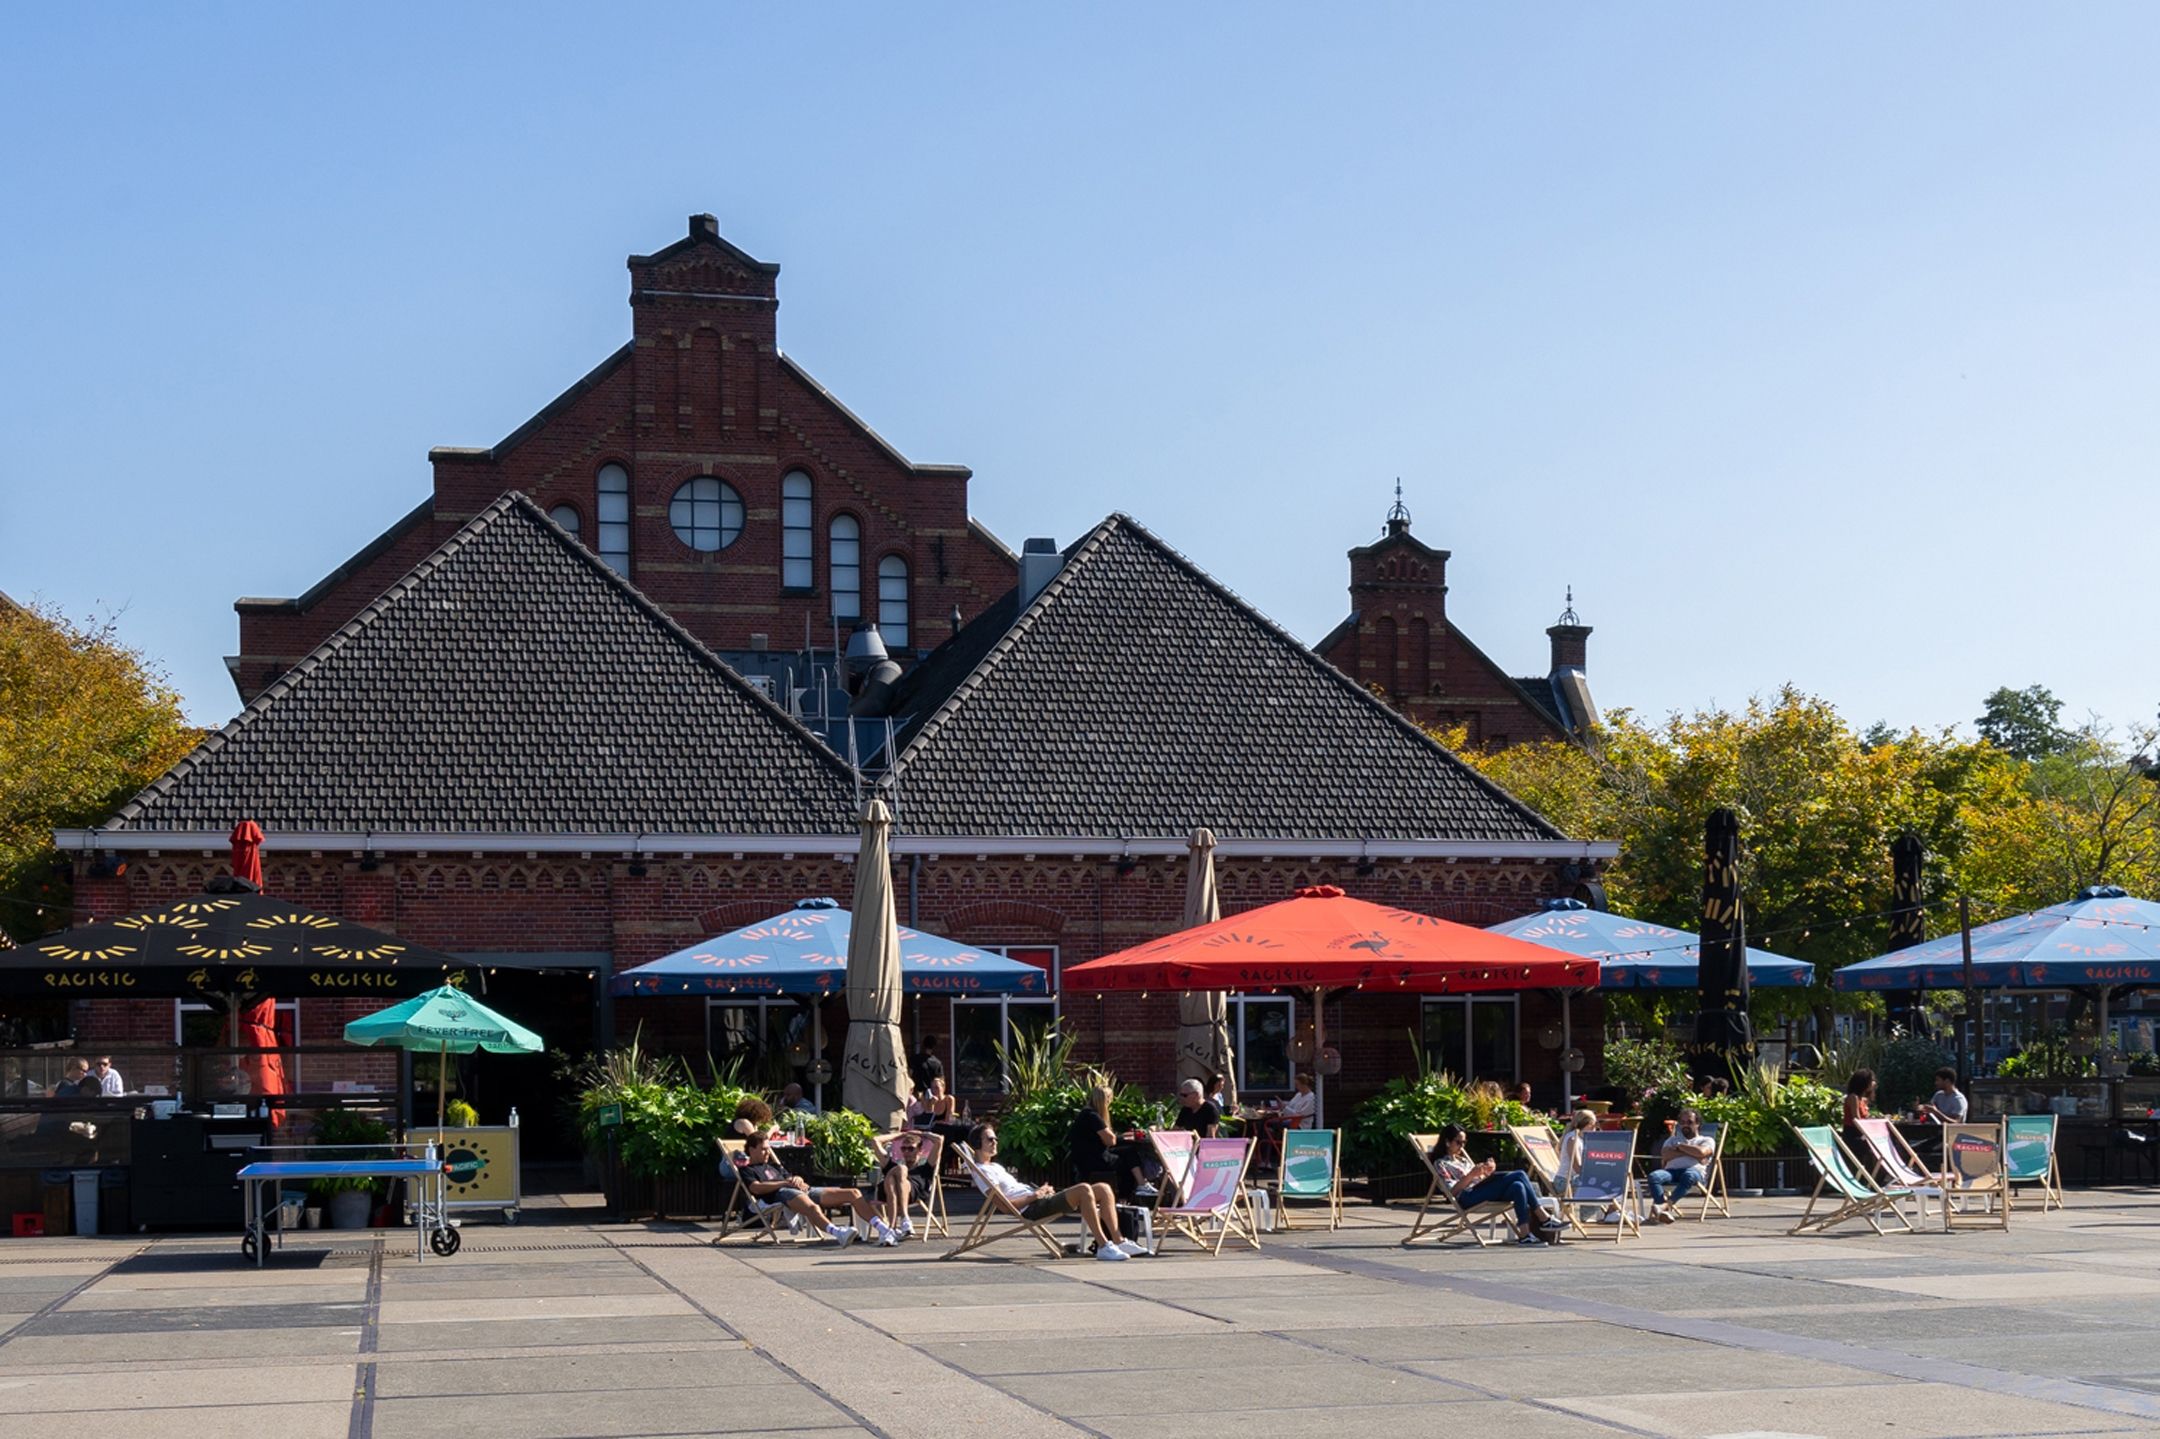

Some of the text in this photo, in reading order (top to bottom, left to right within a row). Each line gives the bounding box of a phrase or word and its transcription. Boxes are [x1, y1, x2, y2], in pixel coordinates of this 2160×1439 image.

[44, 972, 136, 986] PACIFIC
[1240, 968, 1314, 981] PACIFIC
[2085, 966, 2151, 979] PACIFIC
[310, 973, 398, 986] PACIFIC
[911, 976, 981, 989] PACIFIC
